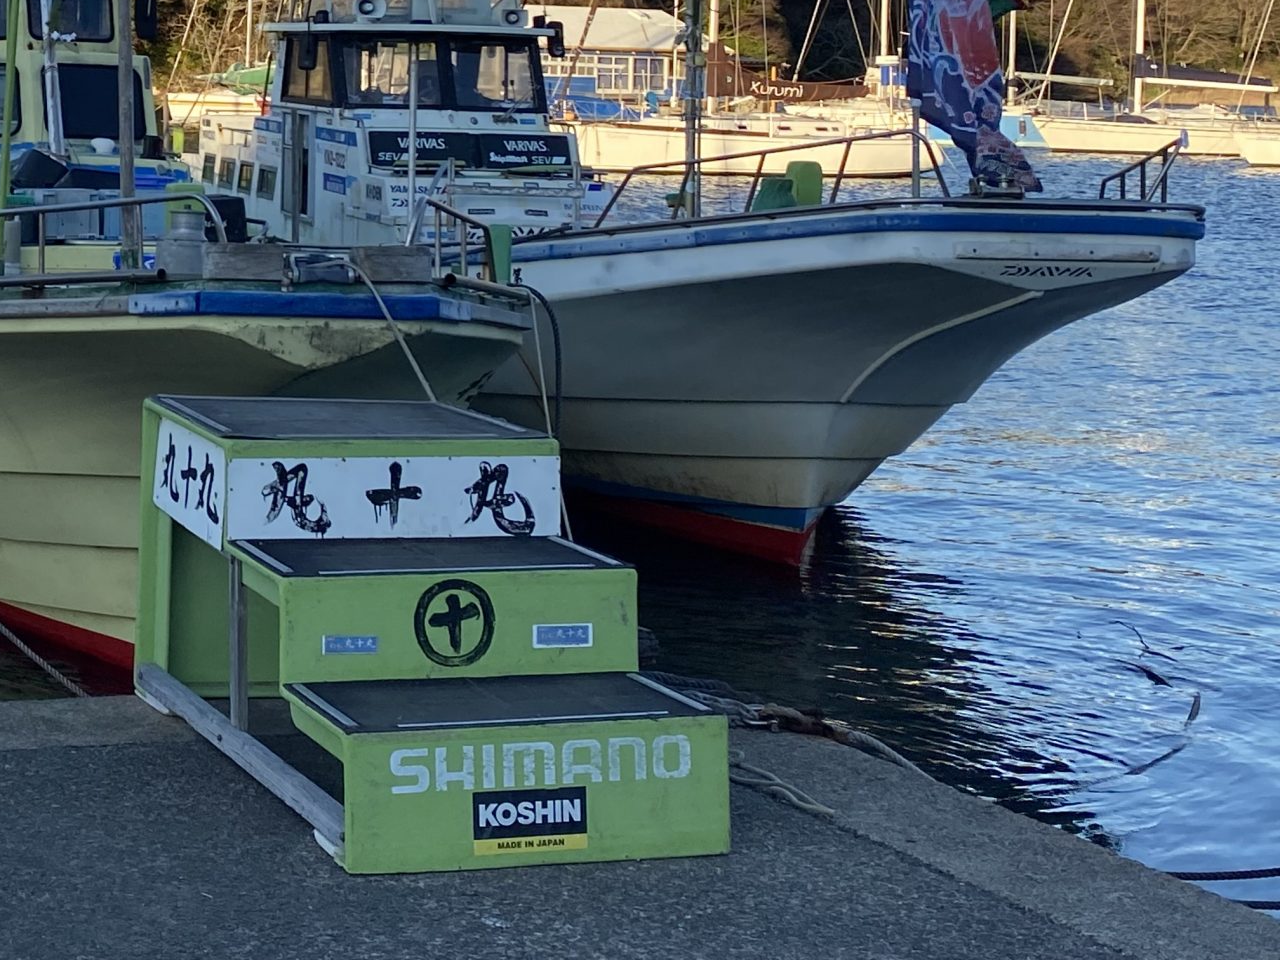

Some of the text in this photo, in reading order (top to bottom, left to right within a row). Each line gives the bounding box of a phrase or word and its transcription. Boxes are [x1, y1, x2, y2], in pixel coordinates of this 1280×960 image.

[750, 81, 803, 97] Kurumi
[503, 140, 547, 151] VARIVAS
[1000, 265, 1093, 278] DAIWA
[160, 433, 220, 525] 丸十丸
[261, 461, 536, 538] 丸十丸
[390, 734, 691, 794] SHIMANO
[478, 799, 581, 827] KOSHIN
[497, 838, 565, 849] MADE IN JAPAN
